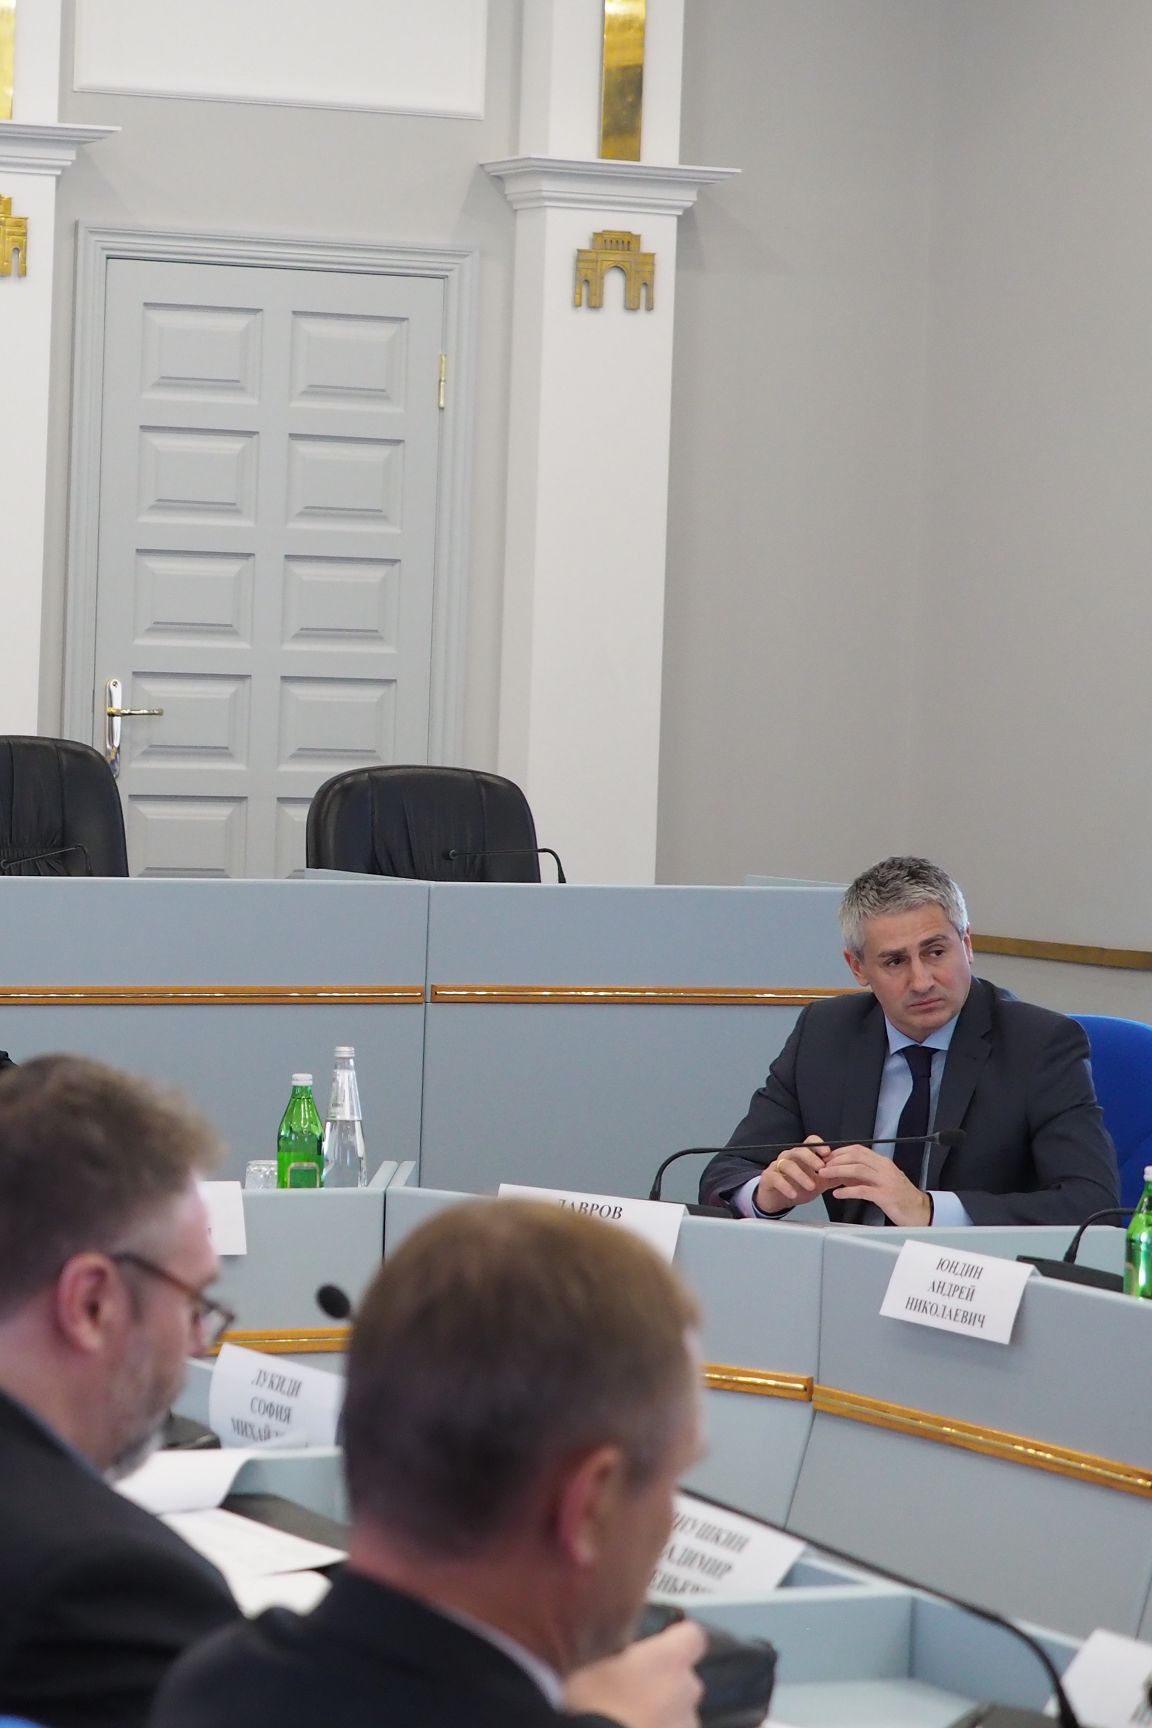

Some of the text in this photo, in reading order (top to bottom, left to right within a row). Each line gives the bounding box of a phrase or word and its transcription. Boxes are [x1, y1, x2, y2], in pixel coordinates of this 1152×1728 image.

[936, 1257, 984, 1280] ЮНДИН
[928, 1279, 976, 1302] АНДРЕЙ
[905, 1296, 986, 1328] НИКОЛАЕВИЧ
[250, 1396, 291, 1424] СОФИЯ
